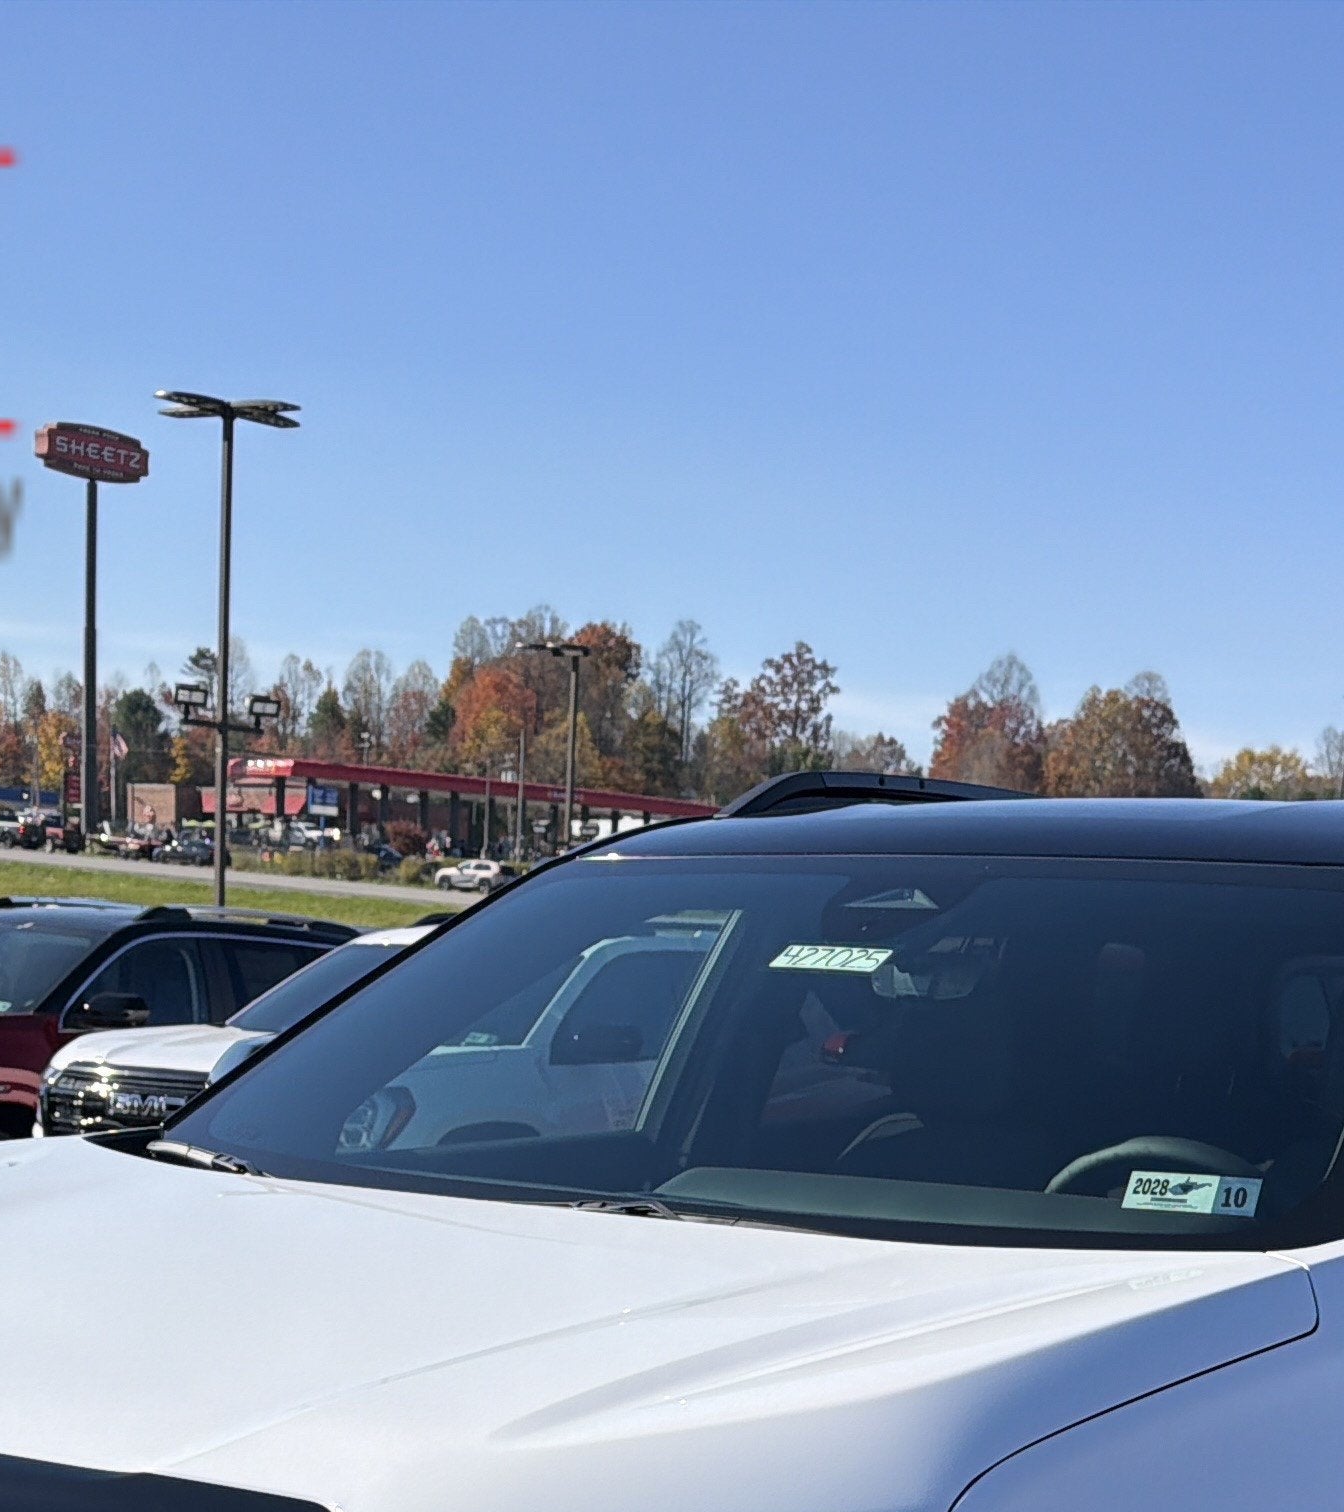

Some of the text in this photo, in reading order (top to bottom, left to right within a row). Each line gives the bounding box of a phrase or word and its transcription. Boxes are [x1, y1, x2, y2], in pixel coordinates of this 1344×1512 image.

[56, 436, 141, 469] SHEETZ
[782, 946, 889, 969] 427025
[1132, 1177, 1170, 1196] 2028
[1220, 1186, 1248, 1208] 10
